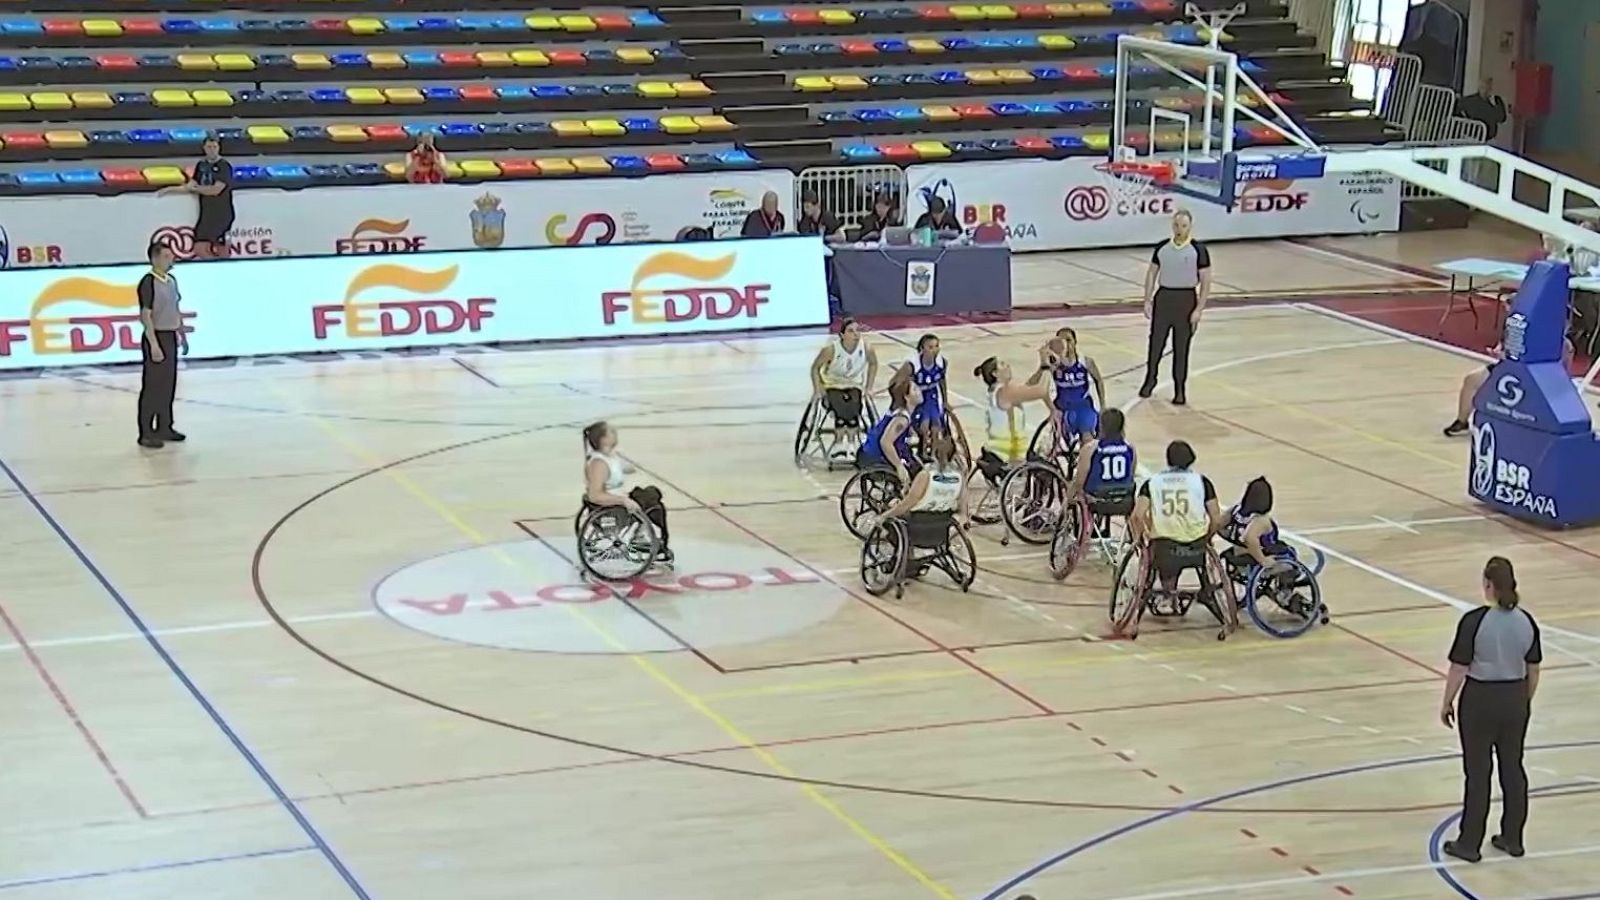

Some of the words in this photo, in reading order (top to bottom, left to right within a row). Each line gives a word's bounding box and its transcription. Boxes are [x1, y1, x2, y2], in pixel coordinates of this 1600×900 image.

[313, 298, 497, 340] FEDDF
[602, 284, 772, 325] FEDDF
[1101, 456, 1127, 480] 10
[1497, 459, 1530, 490] BSR
[1161, 489, 1190, 517] 55
[1495, 483, 1557, 518] ESPAÑA
[399, 566, 821, 616] TOYOTA
